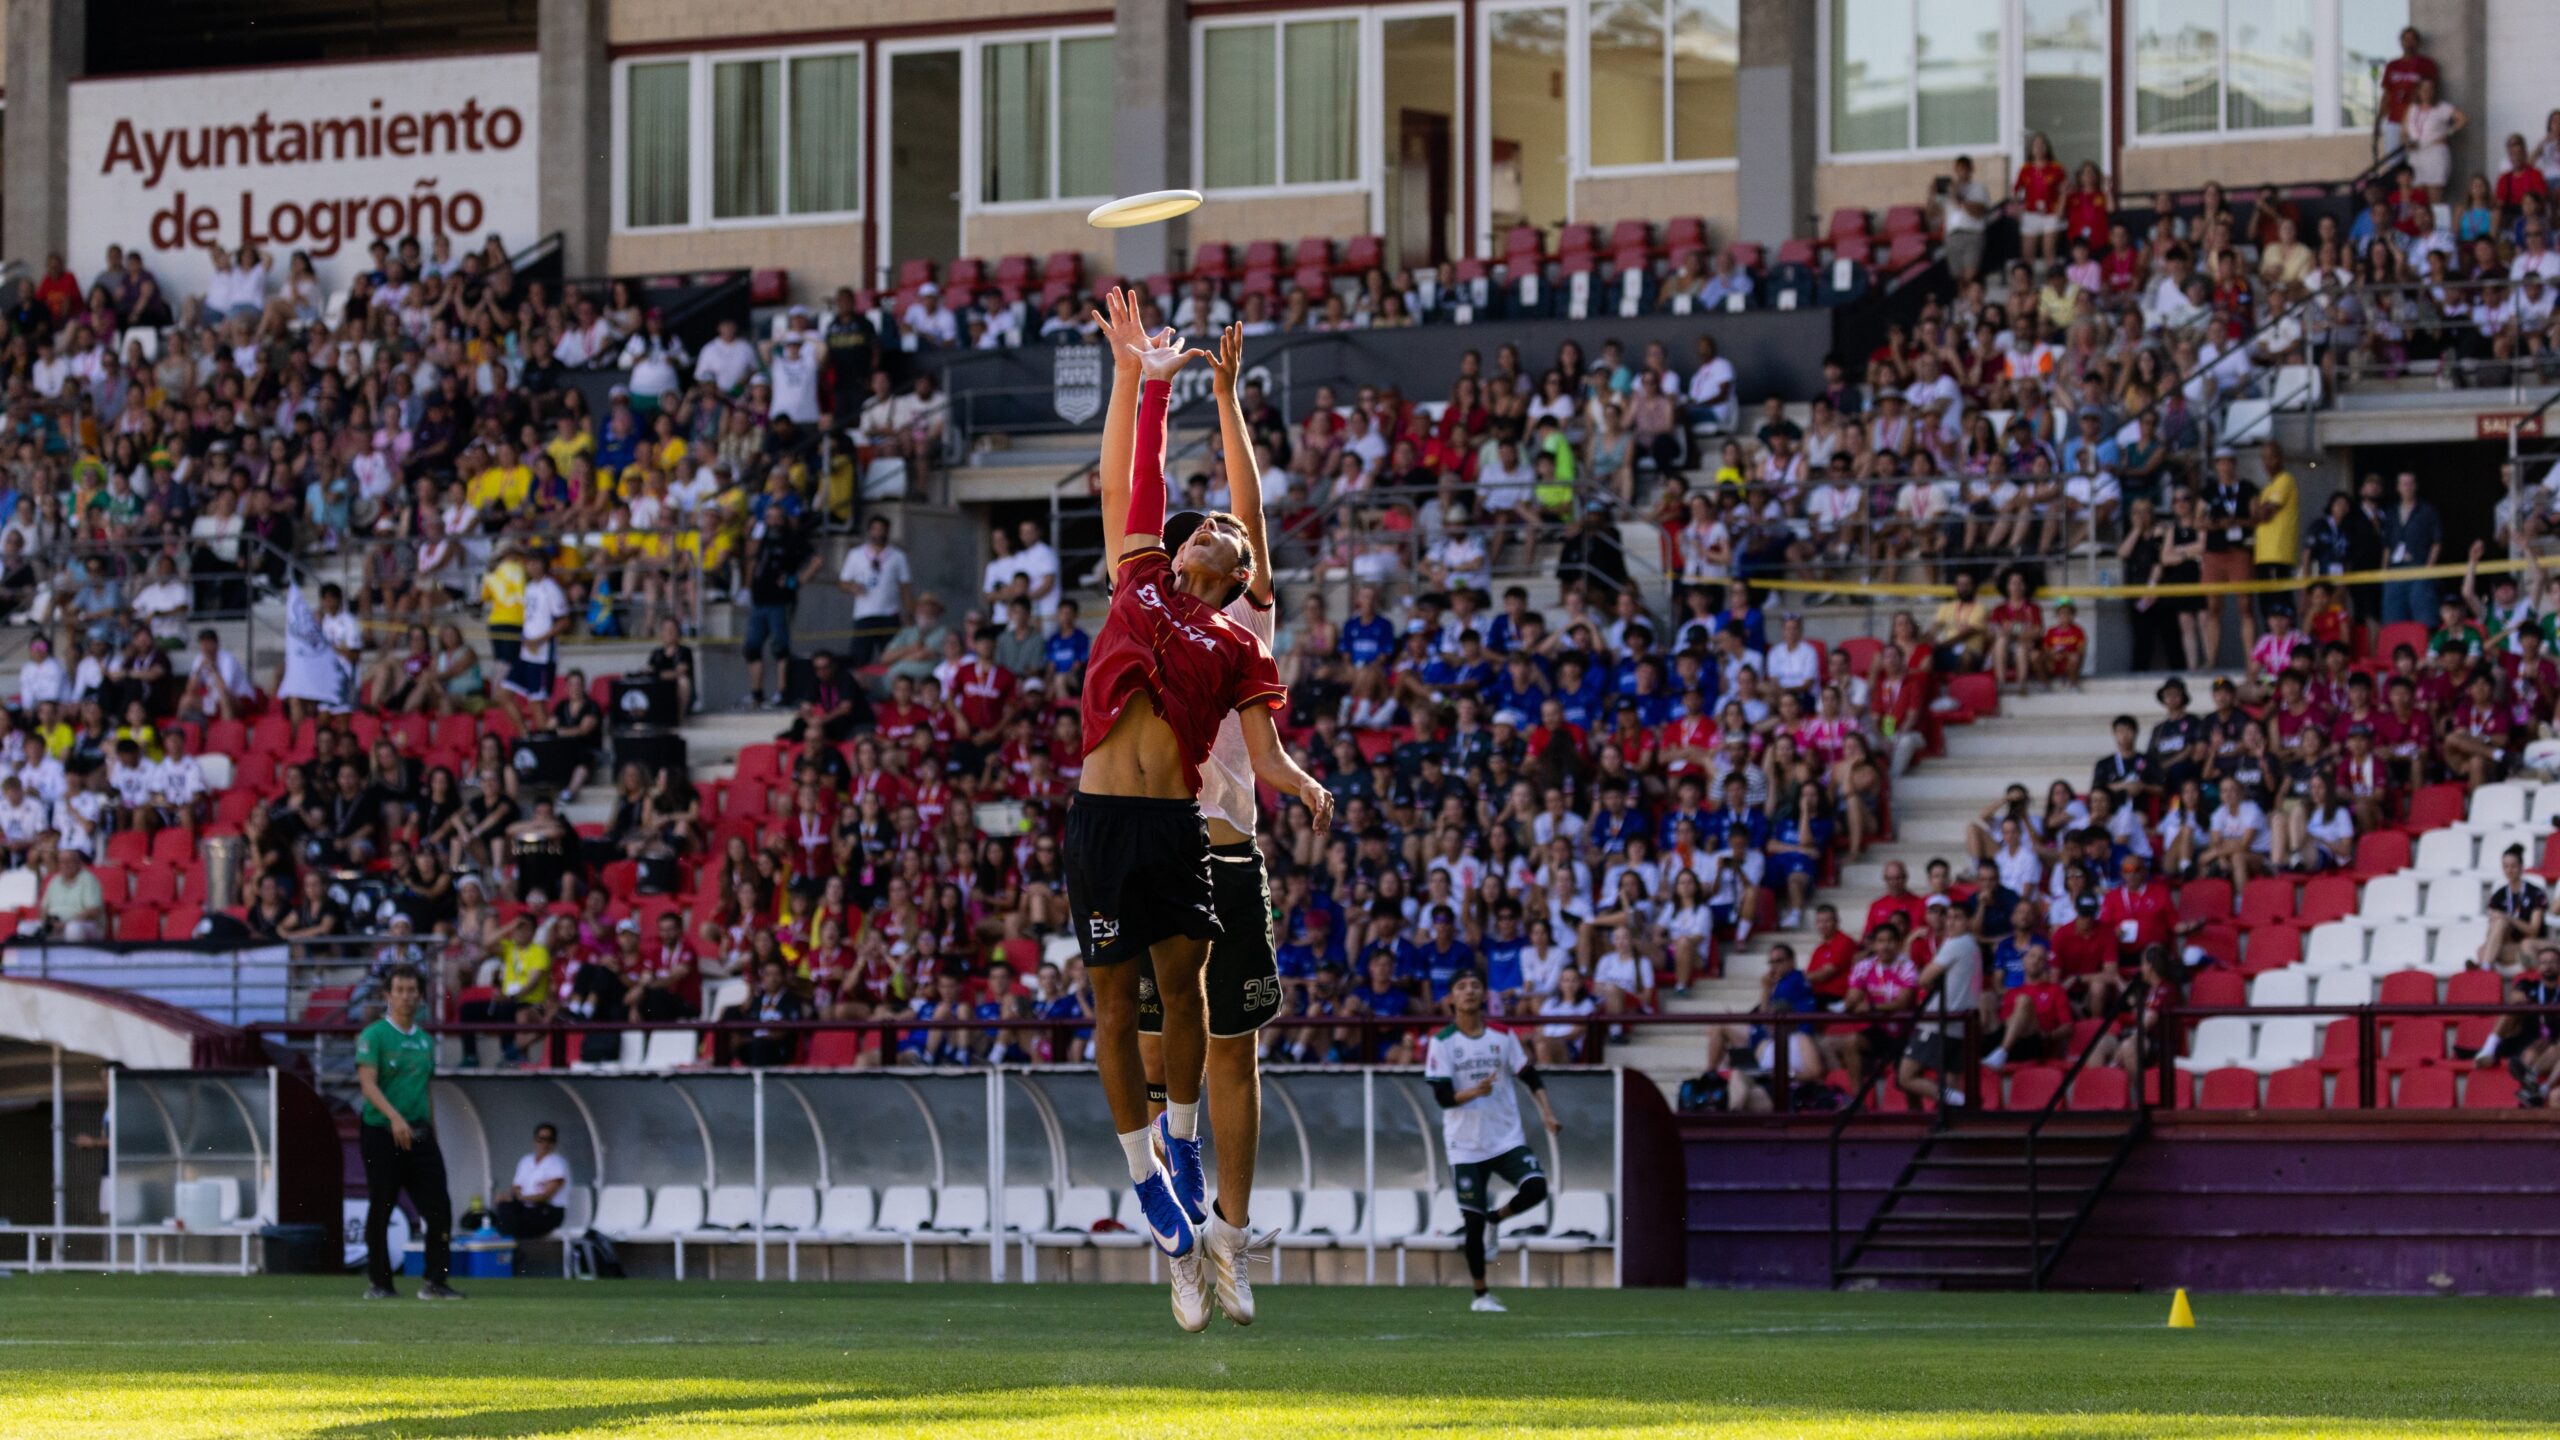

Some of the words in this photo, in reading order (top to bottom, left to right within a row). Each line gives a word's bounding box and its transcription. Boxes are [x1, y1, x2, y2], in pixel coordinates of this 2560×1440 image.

[102, 98, 523, 189] Ayuntamiento
[150, 192, 220, 251] de
[240, 177, 484, 258] Logroño
[1243, 975, 1278, 1012] 35
